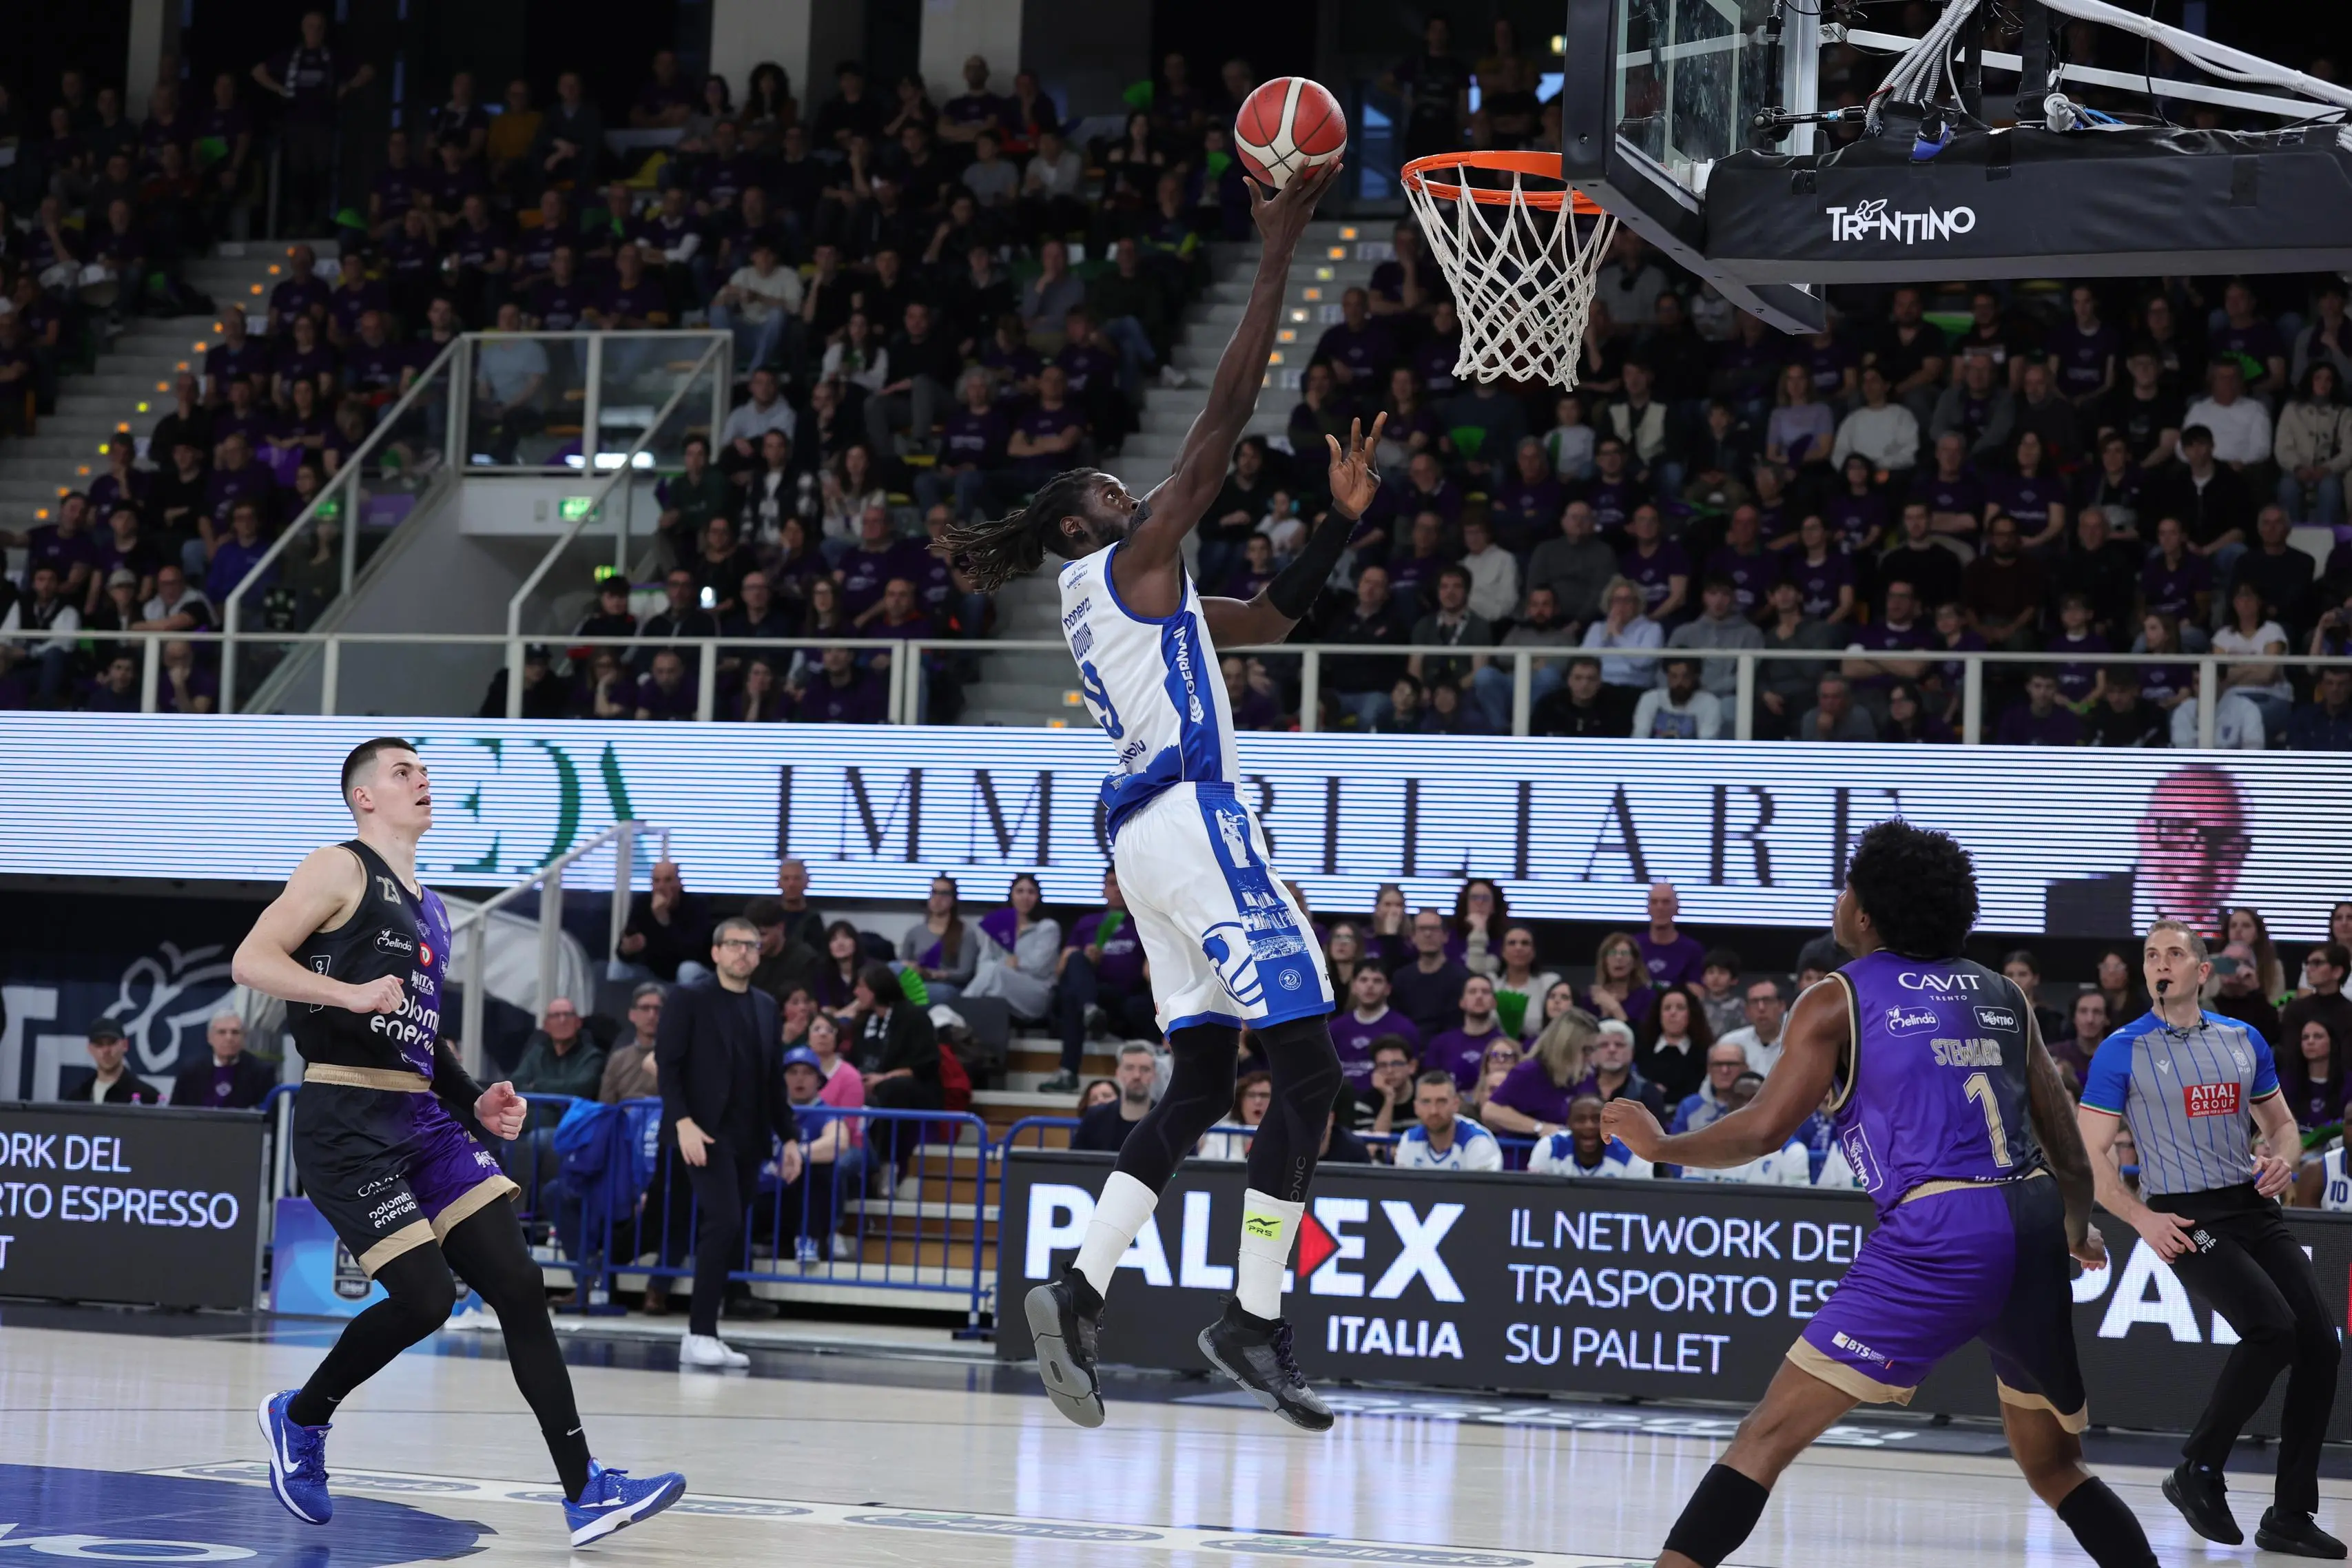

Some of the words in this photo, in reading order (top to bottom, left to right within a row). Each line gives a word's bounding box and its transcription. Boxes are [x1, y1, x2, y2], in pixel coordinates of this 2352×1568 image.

[1826, 201, 1976, 245] TRENTINO
[1081, 659, 1124, 740] 9
[772, 764, 1899, 889] IMMILIARE
[375, 876, 402, 905] 23
[377, 936, 412, 951] Melinda
[1898, 972, 1980, 992] CAVIT
[1890, 1012, 1937, 1031] Melinda
[1979, 1011, 2014, 1026] TRENTINO
[2191, 1084, 2236, 1101] ATTAL
[2191, 1099, 2235, 1111] GROUP
[1963, 1073, 2013, 1168] 1
[65, 1135, 132, 1173] DEL
[61, 1185, 239, 1230] ESPRESSO
[2329, 1180, 2348, 1204] 10
[1024, 1183, 1465, 1303] PLEX
[1248, 1225, 1273, 1237] PRS
[1510, 1208, 1545, 1248] IL
[1554, 1210, 1781, 1260] NETWORK
[2201, 1238, 2217, 1254] FIP
[1507, 1263, 1777, 1317] TRASPORTO
[1326, 1314, 1464, 1359] ITALIA
[1505, 1323, 1561, 1365] SU
[1572, 1326, 1731, 1374] PALLET
[1846, 1339, 1871, 1357] BTS
